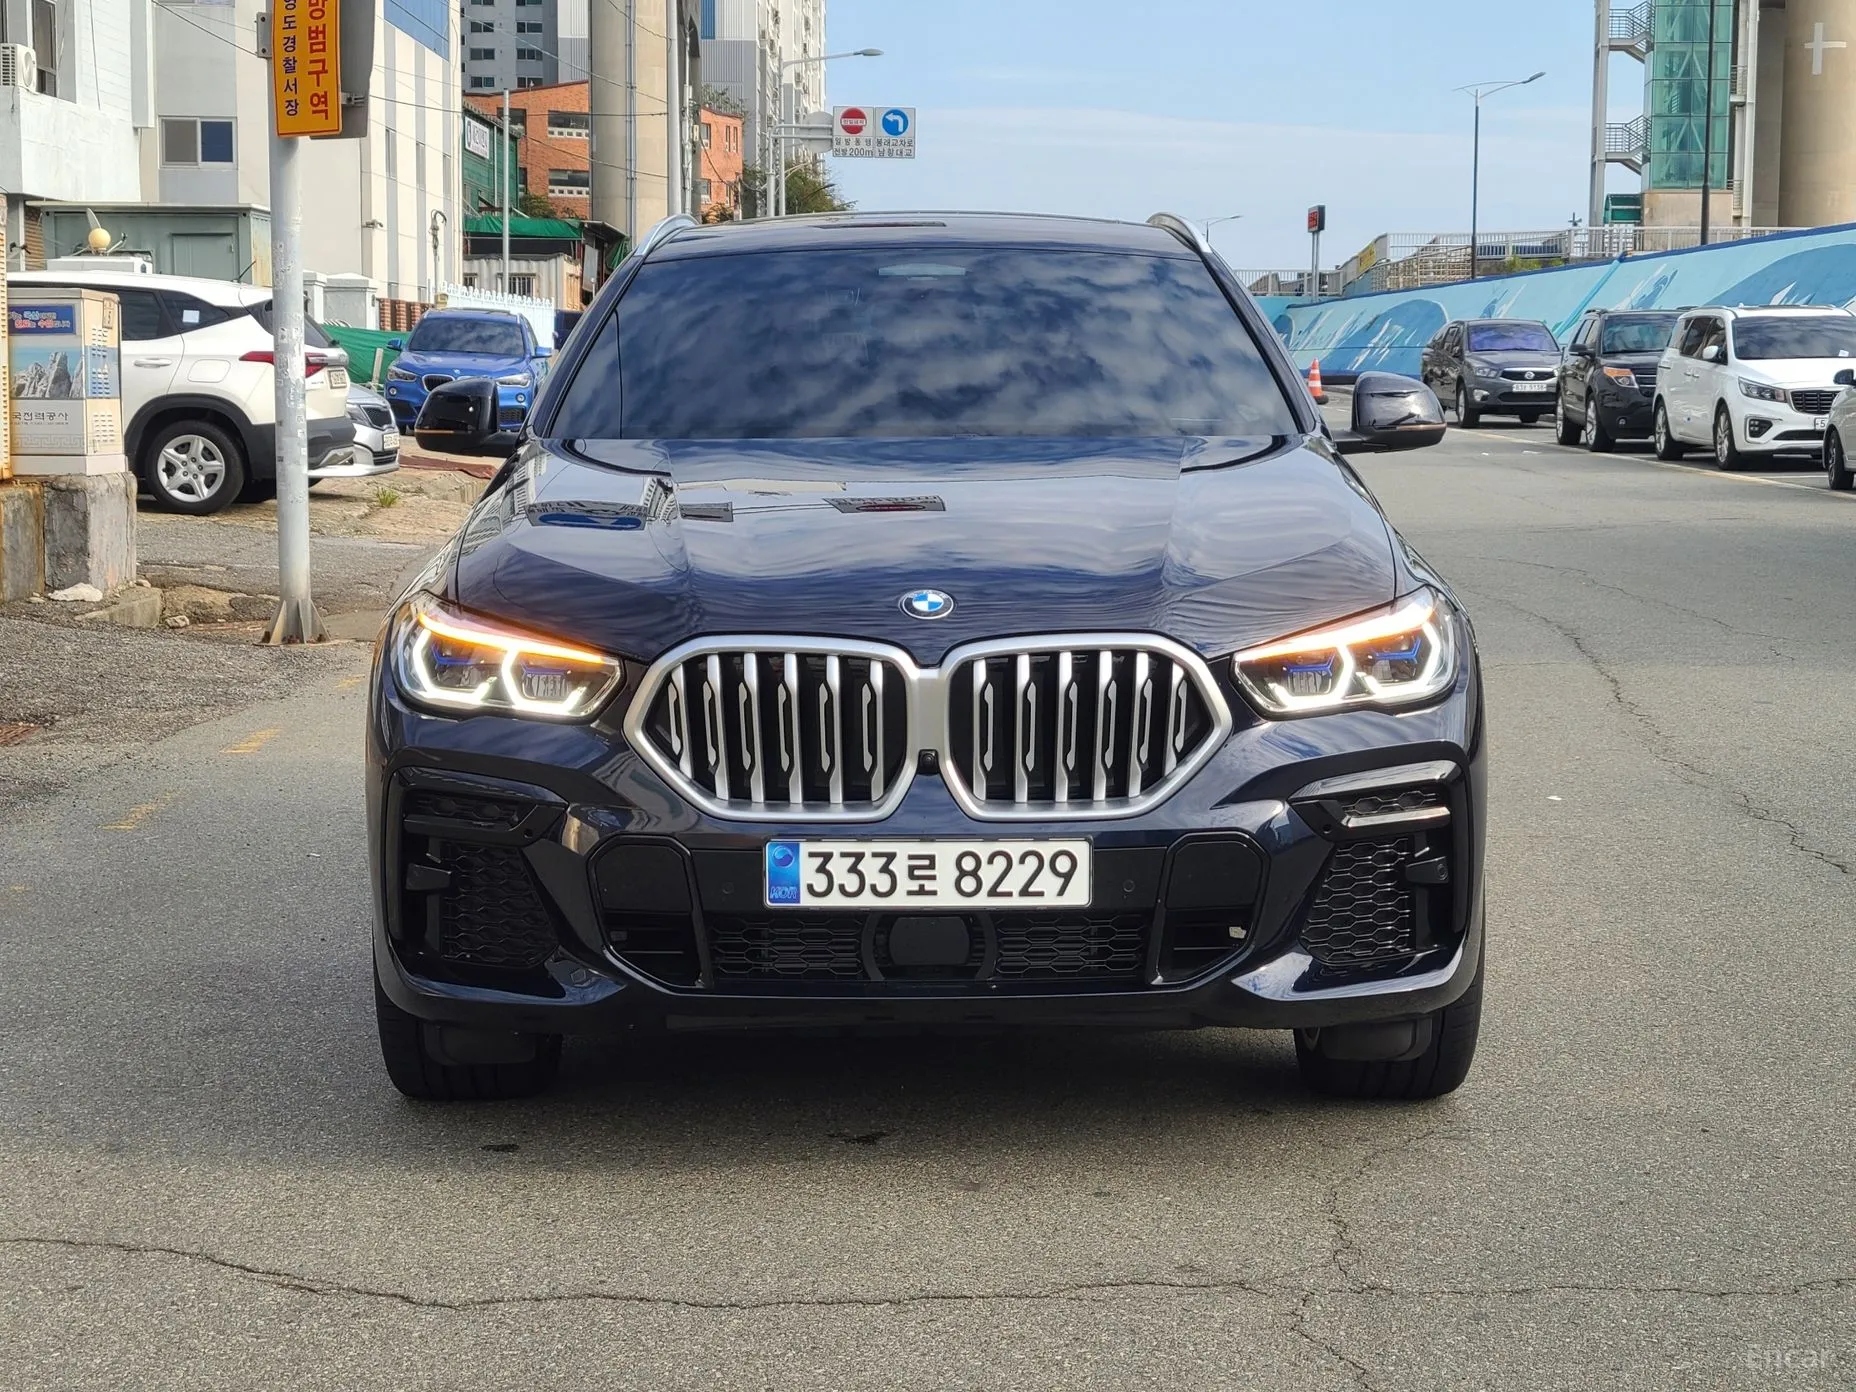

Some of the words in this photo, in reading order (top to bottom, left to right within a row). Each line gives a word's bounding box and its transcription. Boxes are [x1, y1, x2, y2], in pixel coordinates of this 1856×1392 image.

[876, 138, 913, 147] 봉래교차로
[849, 147, 873, 156] 200m
[878, 148, 912, 157] 남항대교
[806, 851, 938, 898] 333로
[954, 849, 1078, 898] 8229
[769, 886, 798, 899] KOR
